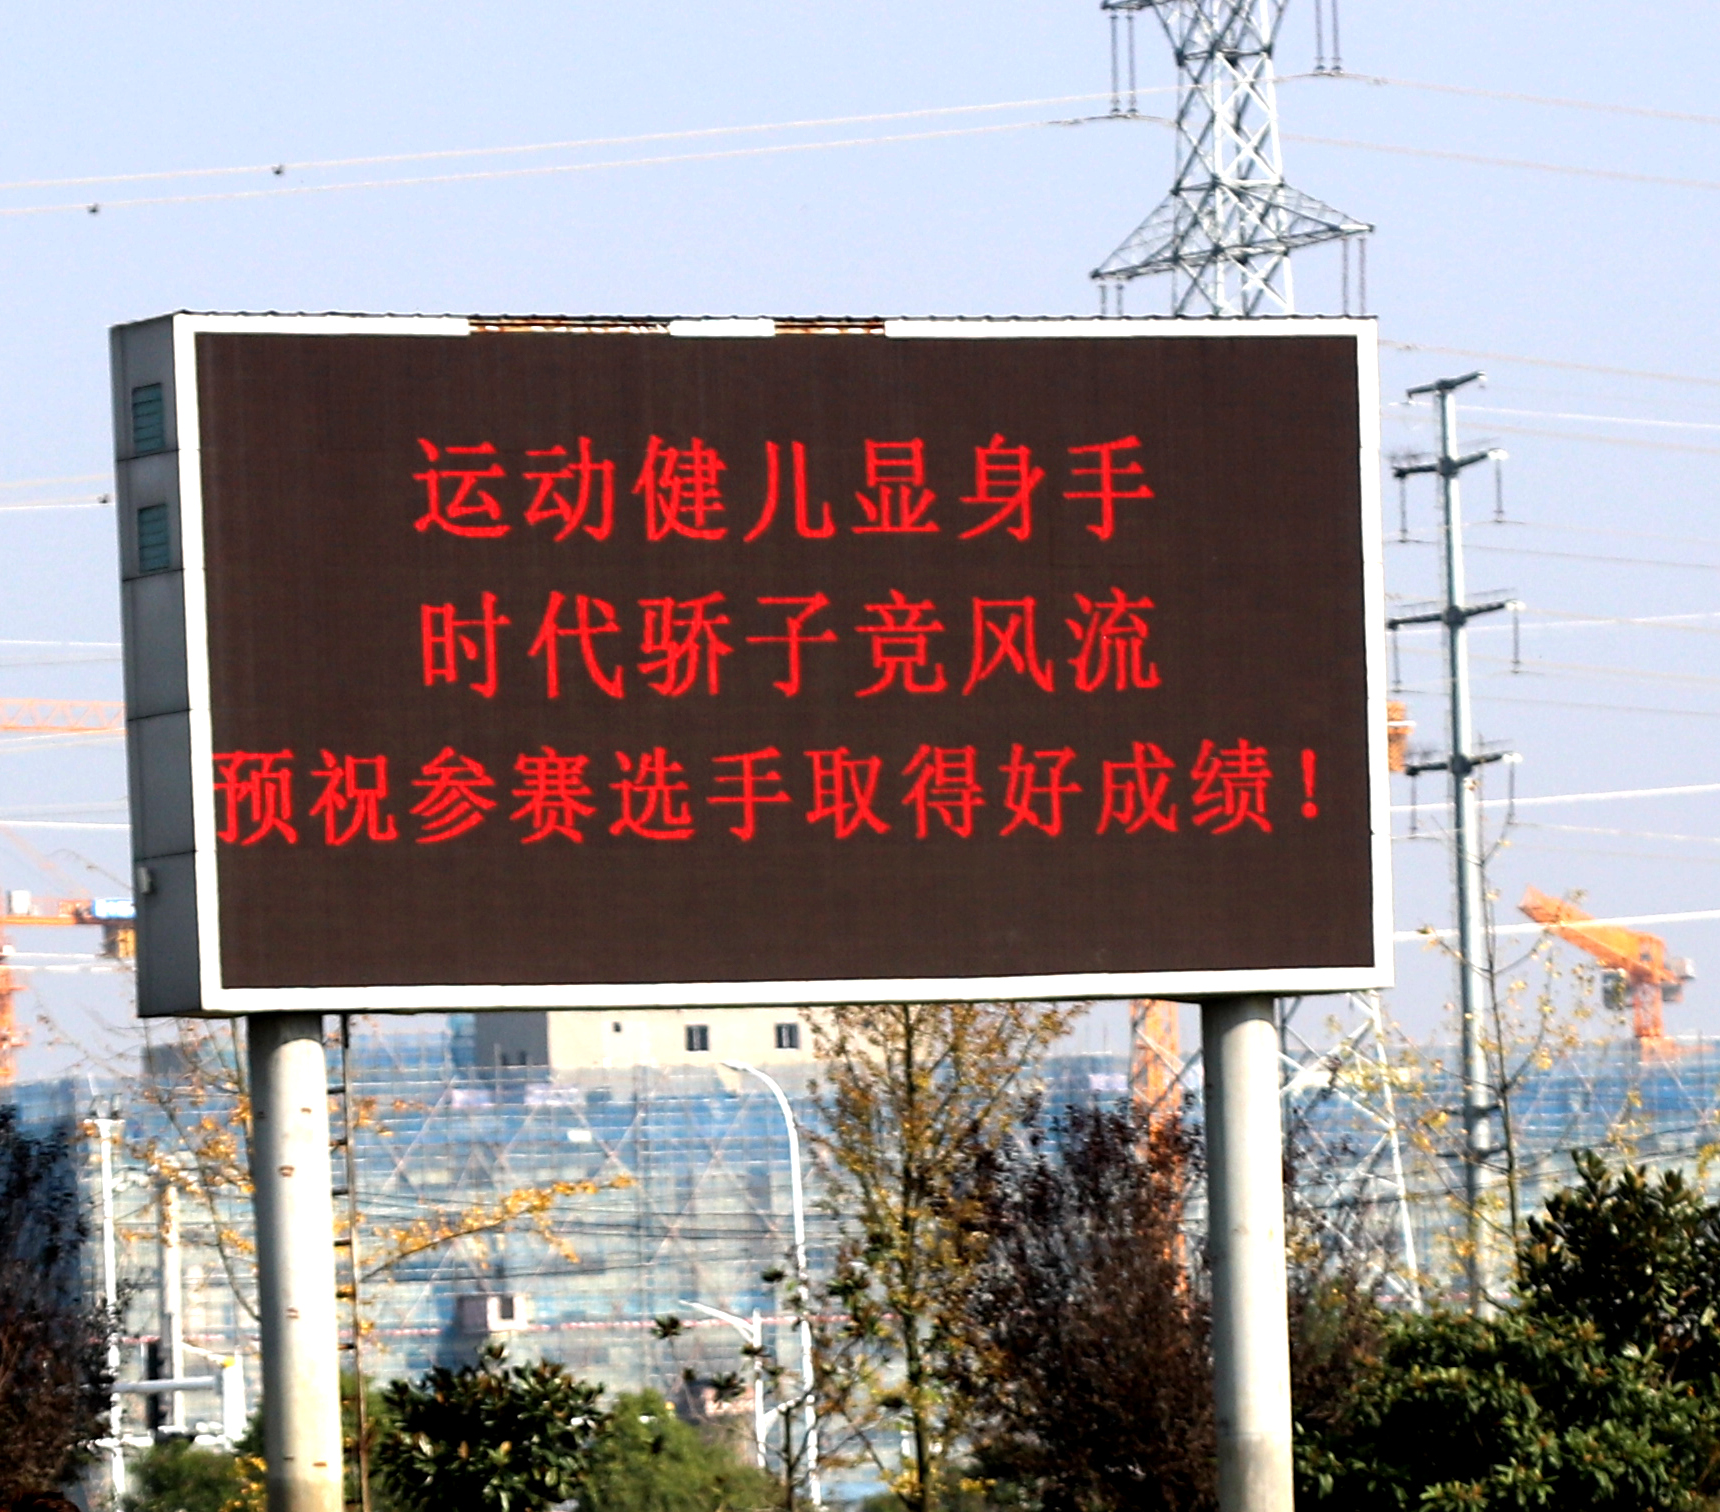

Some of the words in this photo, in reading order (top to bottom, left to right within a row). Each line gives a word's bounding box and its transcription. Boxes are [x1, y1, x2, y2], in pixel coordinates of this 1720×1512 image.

[413, 433, 1154, 543] 运动健儿显身手
[420, 587, 1162, 699] 时代骄子竞风流
